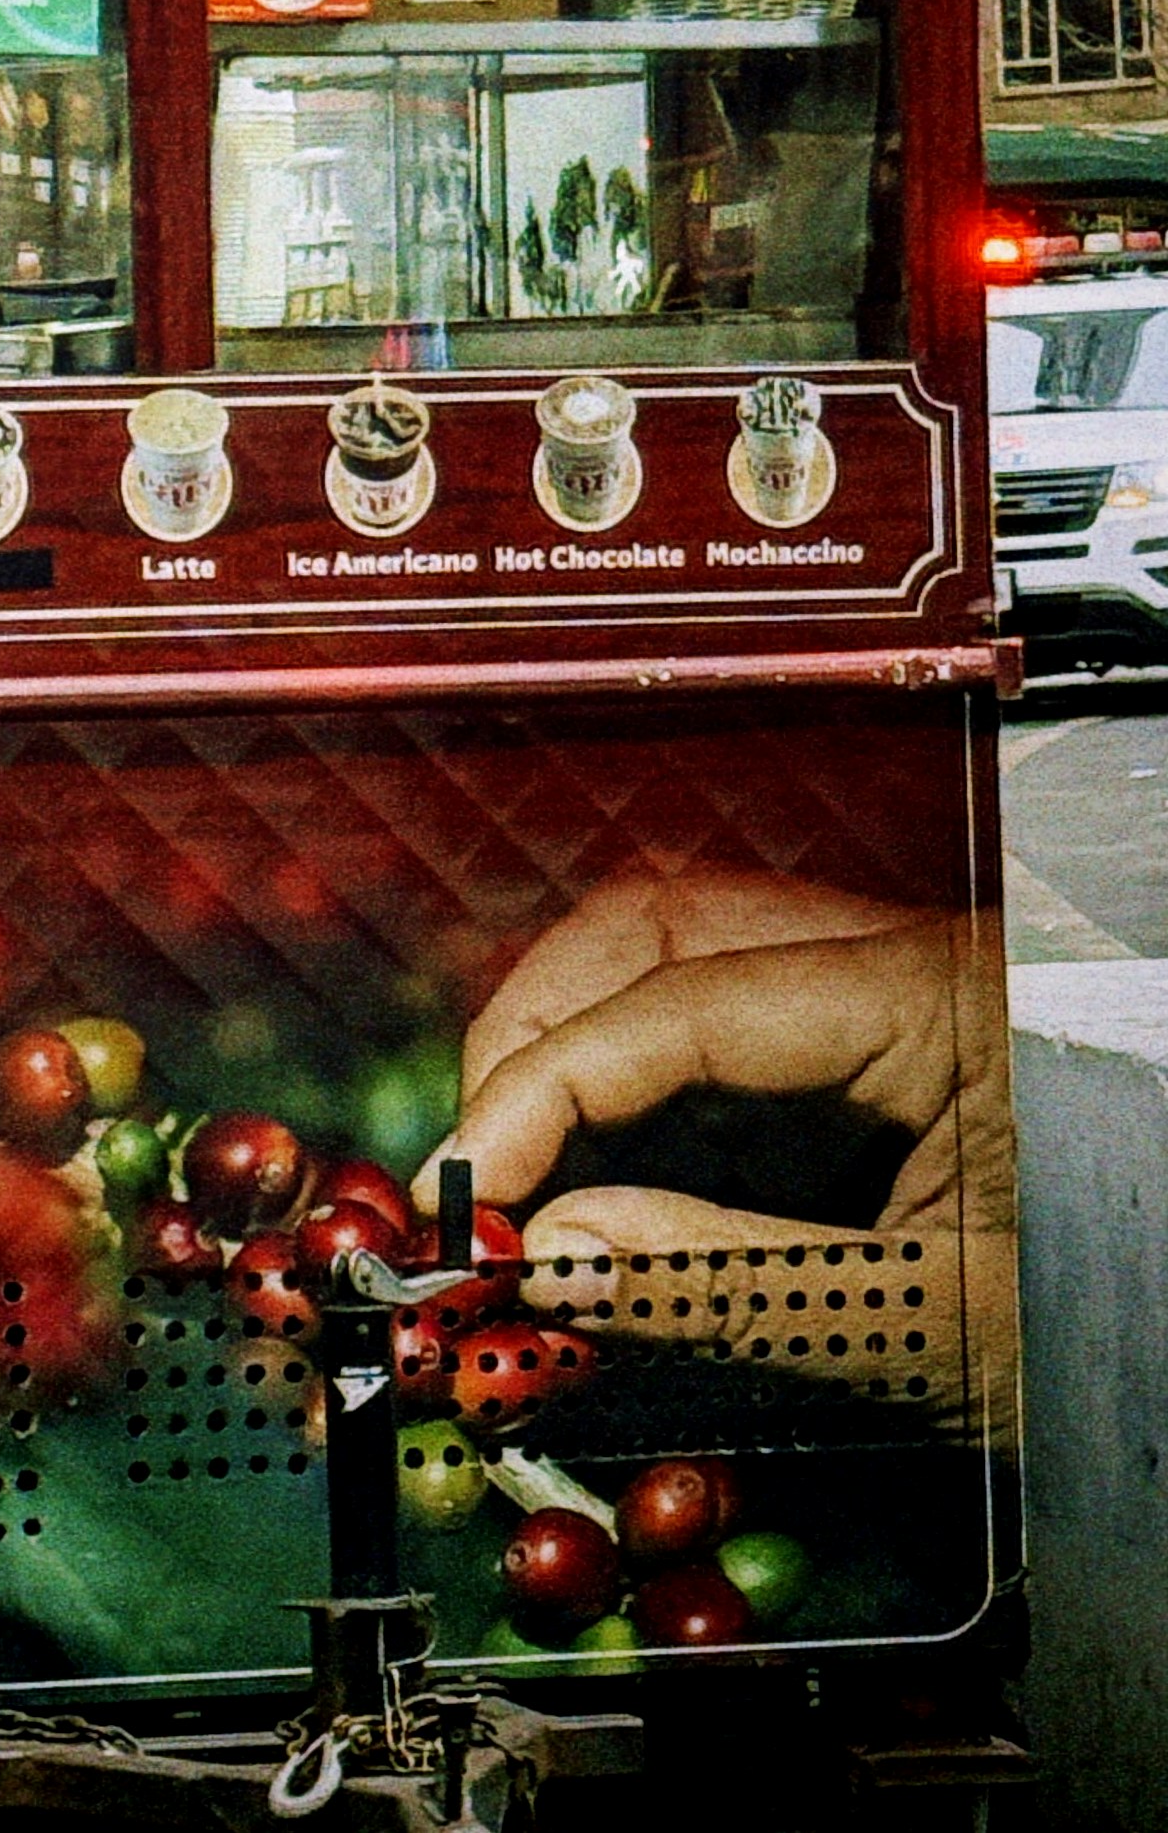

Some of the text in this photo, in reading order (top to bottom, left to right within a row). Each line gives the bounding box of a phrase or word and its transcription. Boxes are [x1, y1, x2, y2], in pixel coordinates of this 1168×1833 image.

[287, 546, 478, 576] Ice Americano
[494, 541, 686, 571] Hot Chocolate
[706, 537, 864, 567] Mochaccino
[141, 555, 217, 581] Latte
